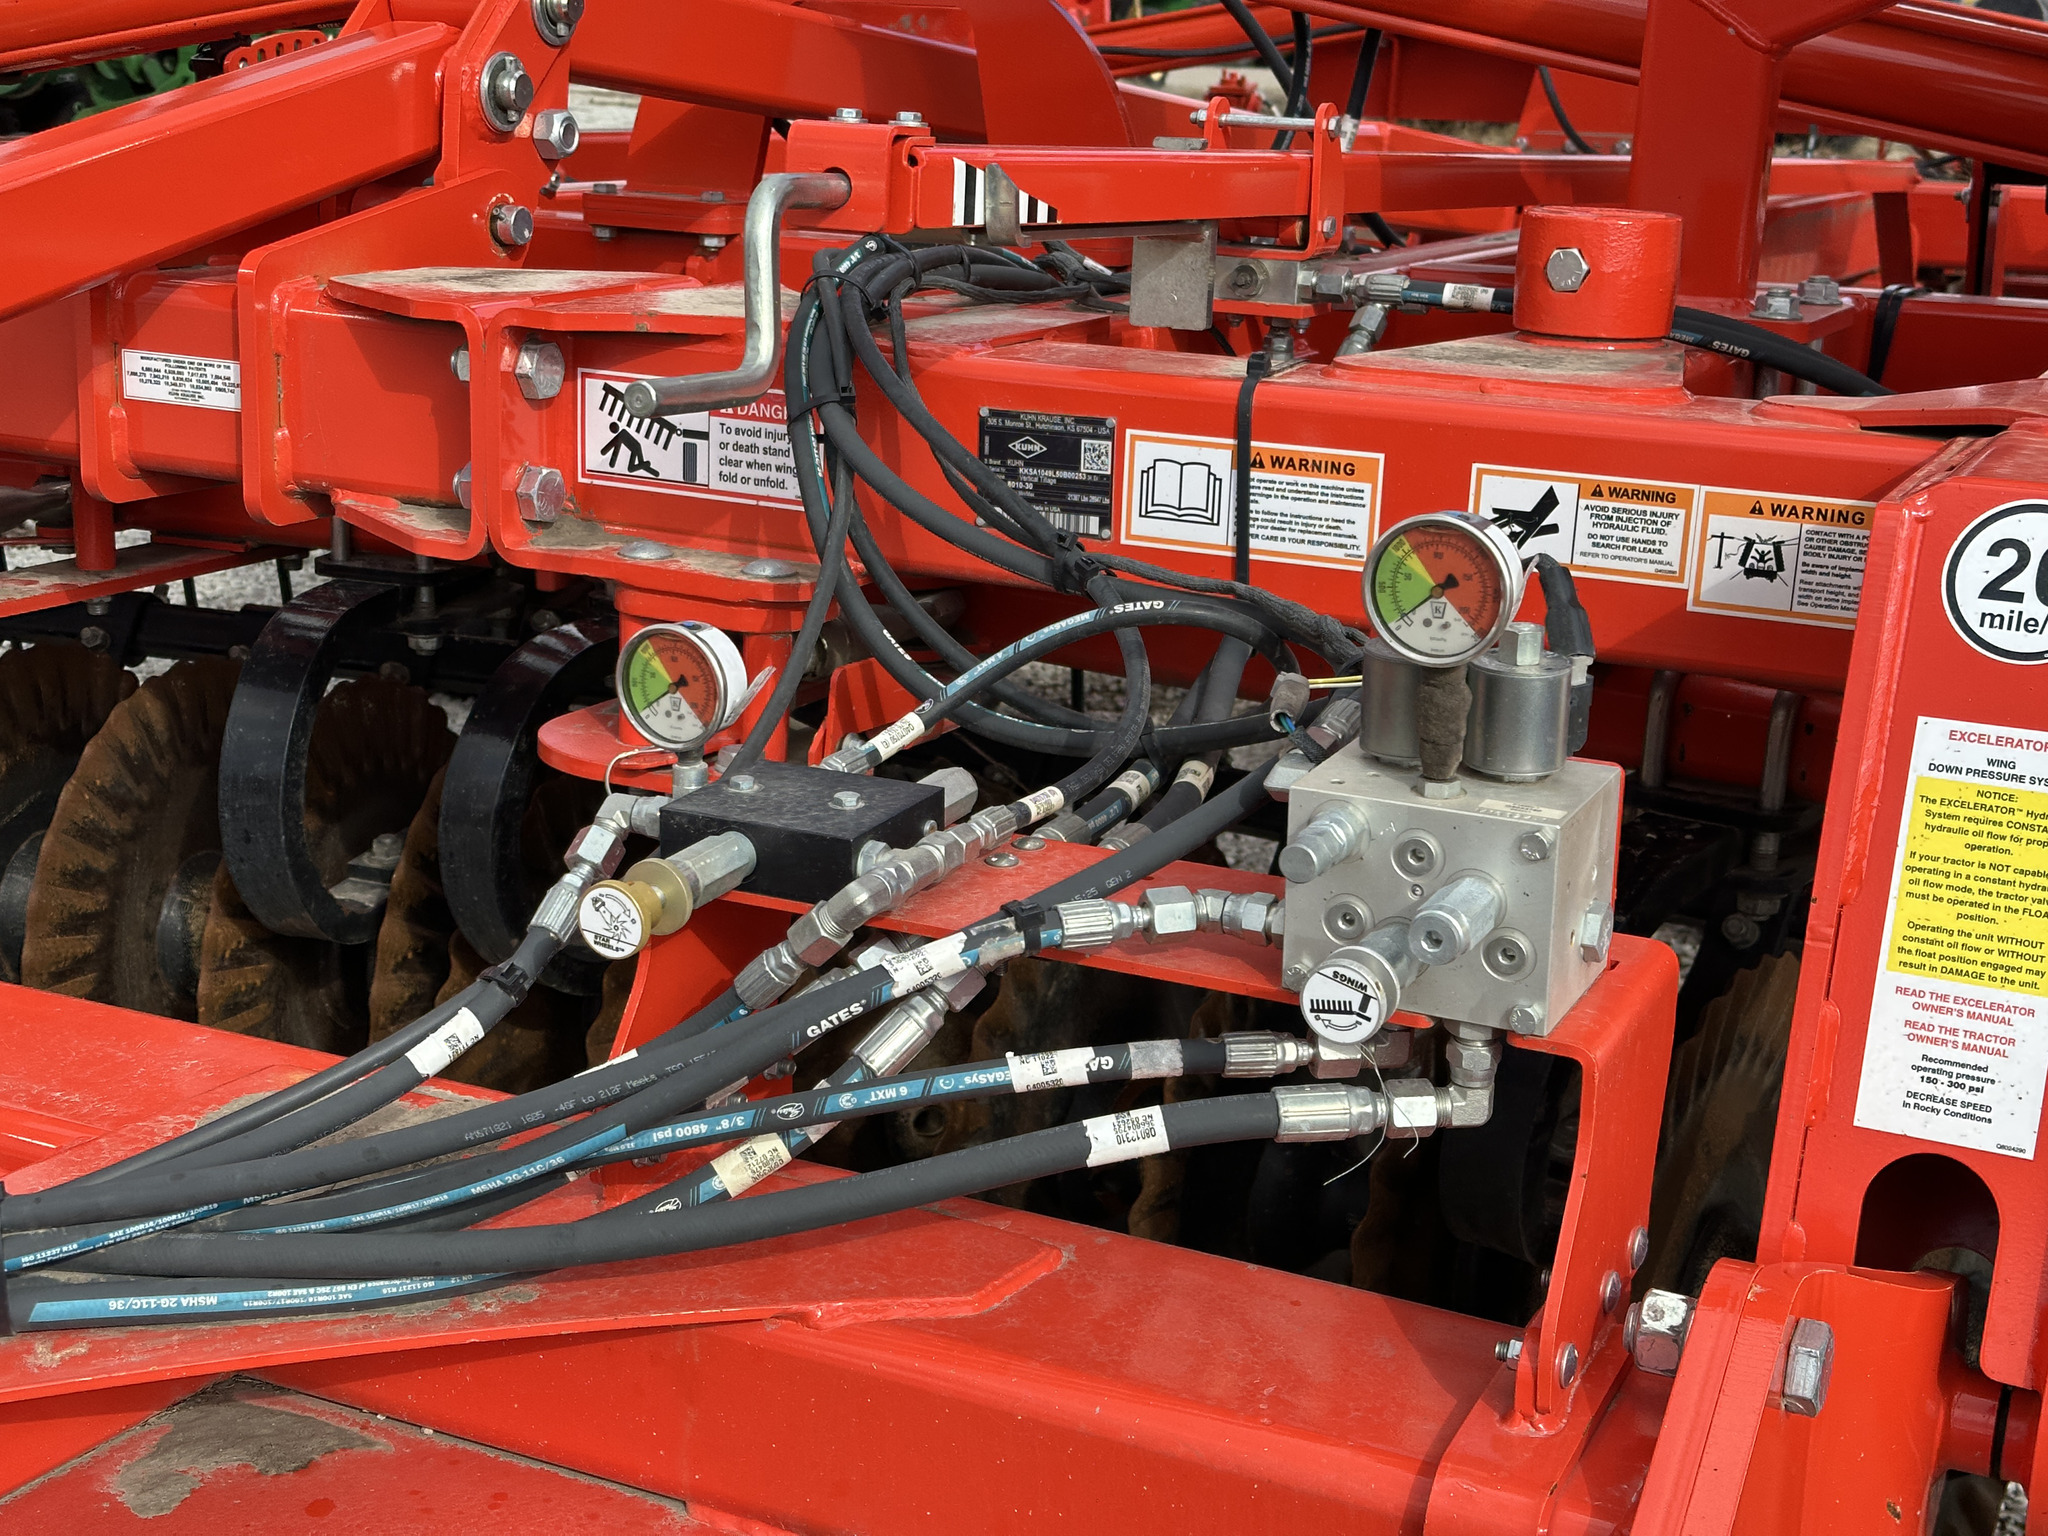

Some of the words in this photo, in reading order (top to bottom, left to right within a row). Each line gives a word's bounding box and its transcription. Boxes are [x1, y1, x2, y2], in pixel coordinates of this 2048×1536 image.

[1712, 340, 1750, 358] GATES
[720, 422, 732, 434] To
[734, 426, 762, 438] avoid
[720, 441, 730, 450] or
[732, 441, 760, 454] death
[762, 446, 790, 458] stand
[1015, 443, 1041, 452] KUHN
[720, 456, 743, 468] clear
[746, 460, 772, 472] when
[1270, 455, 1356, 476] WARNING
[719, 470, 738, 484] fold
[740, 476, 751, 486] or
[754, 476, 788, 490] unfold.
[1608, 486, 1676, 504] WARNING
[1584, 504, 1609, 514] AVOID
[1611, 507, 1647, 517] SERIOUS
[1649, 511, 1680, 521] INJURY
[1590, 513, 1613, 522] FROM
[1615, 515, 1658, 526] INJECTION
[1660, 520, 1672, 528] OF
[1770, 502, 1866, 525] WARNING
[1592, 521, 1639, 533] HYDRAULIC
[1641, 526, 1668, 536] FLUID.
[1591, 541, 1620, 550] SEARCH
[1622, 544, 1637, 552] FOR
[1638, 546, 1664, 555] LEAKS.
[1600, 534, 1614, 542] NOT
[1616, 535, 1630, 543] USE
[1631, 537, 1657, 546] HANDS
[1580, 550, 1600, 559] REFER
[1601, 552, 1609, 560] TO
[1610, 553, 1647, 564] OPERATOR'S
[1649, 558, 1674, 567] MANUAL
[1978, 538, 2048, 607] 2
[1114, 600, 1164, 614] GATES
[1928, 762, 1963, 775] DOWN
[1966, 768, 2026, 784] PRESSURE
[1986, 757, 2016, 770] WING
[1920, 795, 1937, 804] The
[1976, 790, 2019, 803] NOTICE:
[1925, 809, 1960, 821] System
[1964, 816, 2004, 828] requires
[1924, 822, 1970, 836] hydraulic
[1972, 830, 1984, 838] oil
[1986, 831, 2008, 841] flow
[2010, 834, 2023, 844] for
[1964, 842, 2014, 856] operation.
[1910, 851, 1916, 859] If
[1918, 854, 1941, 864] your
[1943, 856, 1975, 868] tractor
[1978, 860, 1986, 870] is
[1989, 861, 2011, 872] NOT
[1905, 864, 1951, 878] operating
[1953, 871, 1962, 879] in
[1974, 876, 2016, 887] constant
[1908, 876, 1920, 886] oil
[1922, 879, 1943, 889] flow
[1945, 885, 1975, 896] mode,
[1978, 888, 1994, 897] the
[1996, 890, 2029, 902] tractor
[1906, 891, 1930, 900] must
[1932, 894, 1944, 903] be
[1947, 898, 1990, 910] operated
[1992, 903, 2001, 911] in
[2004, 905, 2020, 914] the
[1956, 912, 1999, 925] position.
[1907, 920, 1954, 936] Operating
[1957, 929, 1972, 939] the
[1975, 933, 1994, 942] unit
[1997, 935, 2045, 950] WITHOUT
[1902, 934, 1944, 947] constant
[1947, 940, 1959, 949] oil
[1961, 943, 1982, 953] flow
[1997, 948, 2046, 963] WITHOUT
[1898, 946, 1913, 956] the
[1915, 949, 1936, 960] float
[1938, 953, 1978, 967] position
[1980, 960, 2023, 974] engaged
[2025, 968, 2046, 979] may
[1332, 970, 1368, 992] WINGS
[1898, 960, 1927, 971] result
[1928, 964, 1938, 973] in
[1940, 966, 1986, 981] DAMAGE
[1988, 974, 1998, 982] to
[2000, 976, 2016, 986] the
[2018, 981, 2040, 990] unit.
[1895, 986, 1926, 999] READ
[1929, 991, 1951, 1003] THE
[1953, 996, 2036, 1018] EXCELERATOR
[806, 1002, 864, 1038] GATES
[1912, 1001, 1964, 1018] OWNER'S
[1966, 1011, 2014, 1027] MANUAL
[1904, 1020, 1935, 1032] READ
[1938, 1025, 1960, 1037] THE
[1963, 1030, 2016, 1047] TRACTOR
[1907, 1033, 1959, 1049] OWNER'S
[1961, 1042, 2009, 1058] MANUAL
[1921, 1054, 1989, 1073] Recommended
[1911, 1064, 1954, 1079] operating
[1955, 1072, 1996, 1085] pressure
[870, 1088, 897, 1100] MXT
[900, 1086, 908, 1096] 6
[1920, 1075, 1938, 1085] 150
[1947, 1080, 1966, 1090] 300
[1968, 1084, 1984, 1094] psi
[1906, 1091, 1958, 1107] DECREASE
[1960, 1100, 1992, 1114] SPEED
[1913, 1103, 1941, 1116] Rocky
[1943, 1108, 1992, 1124] Conditions
[653, 1128, 673, 1142] psi
[676, 1124, 708, 1137] 4800
[470, 1180, 504, 1196] MSHA
[181, 1296, 218, 1306] MSHA
